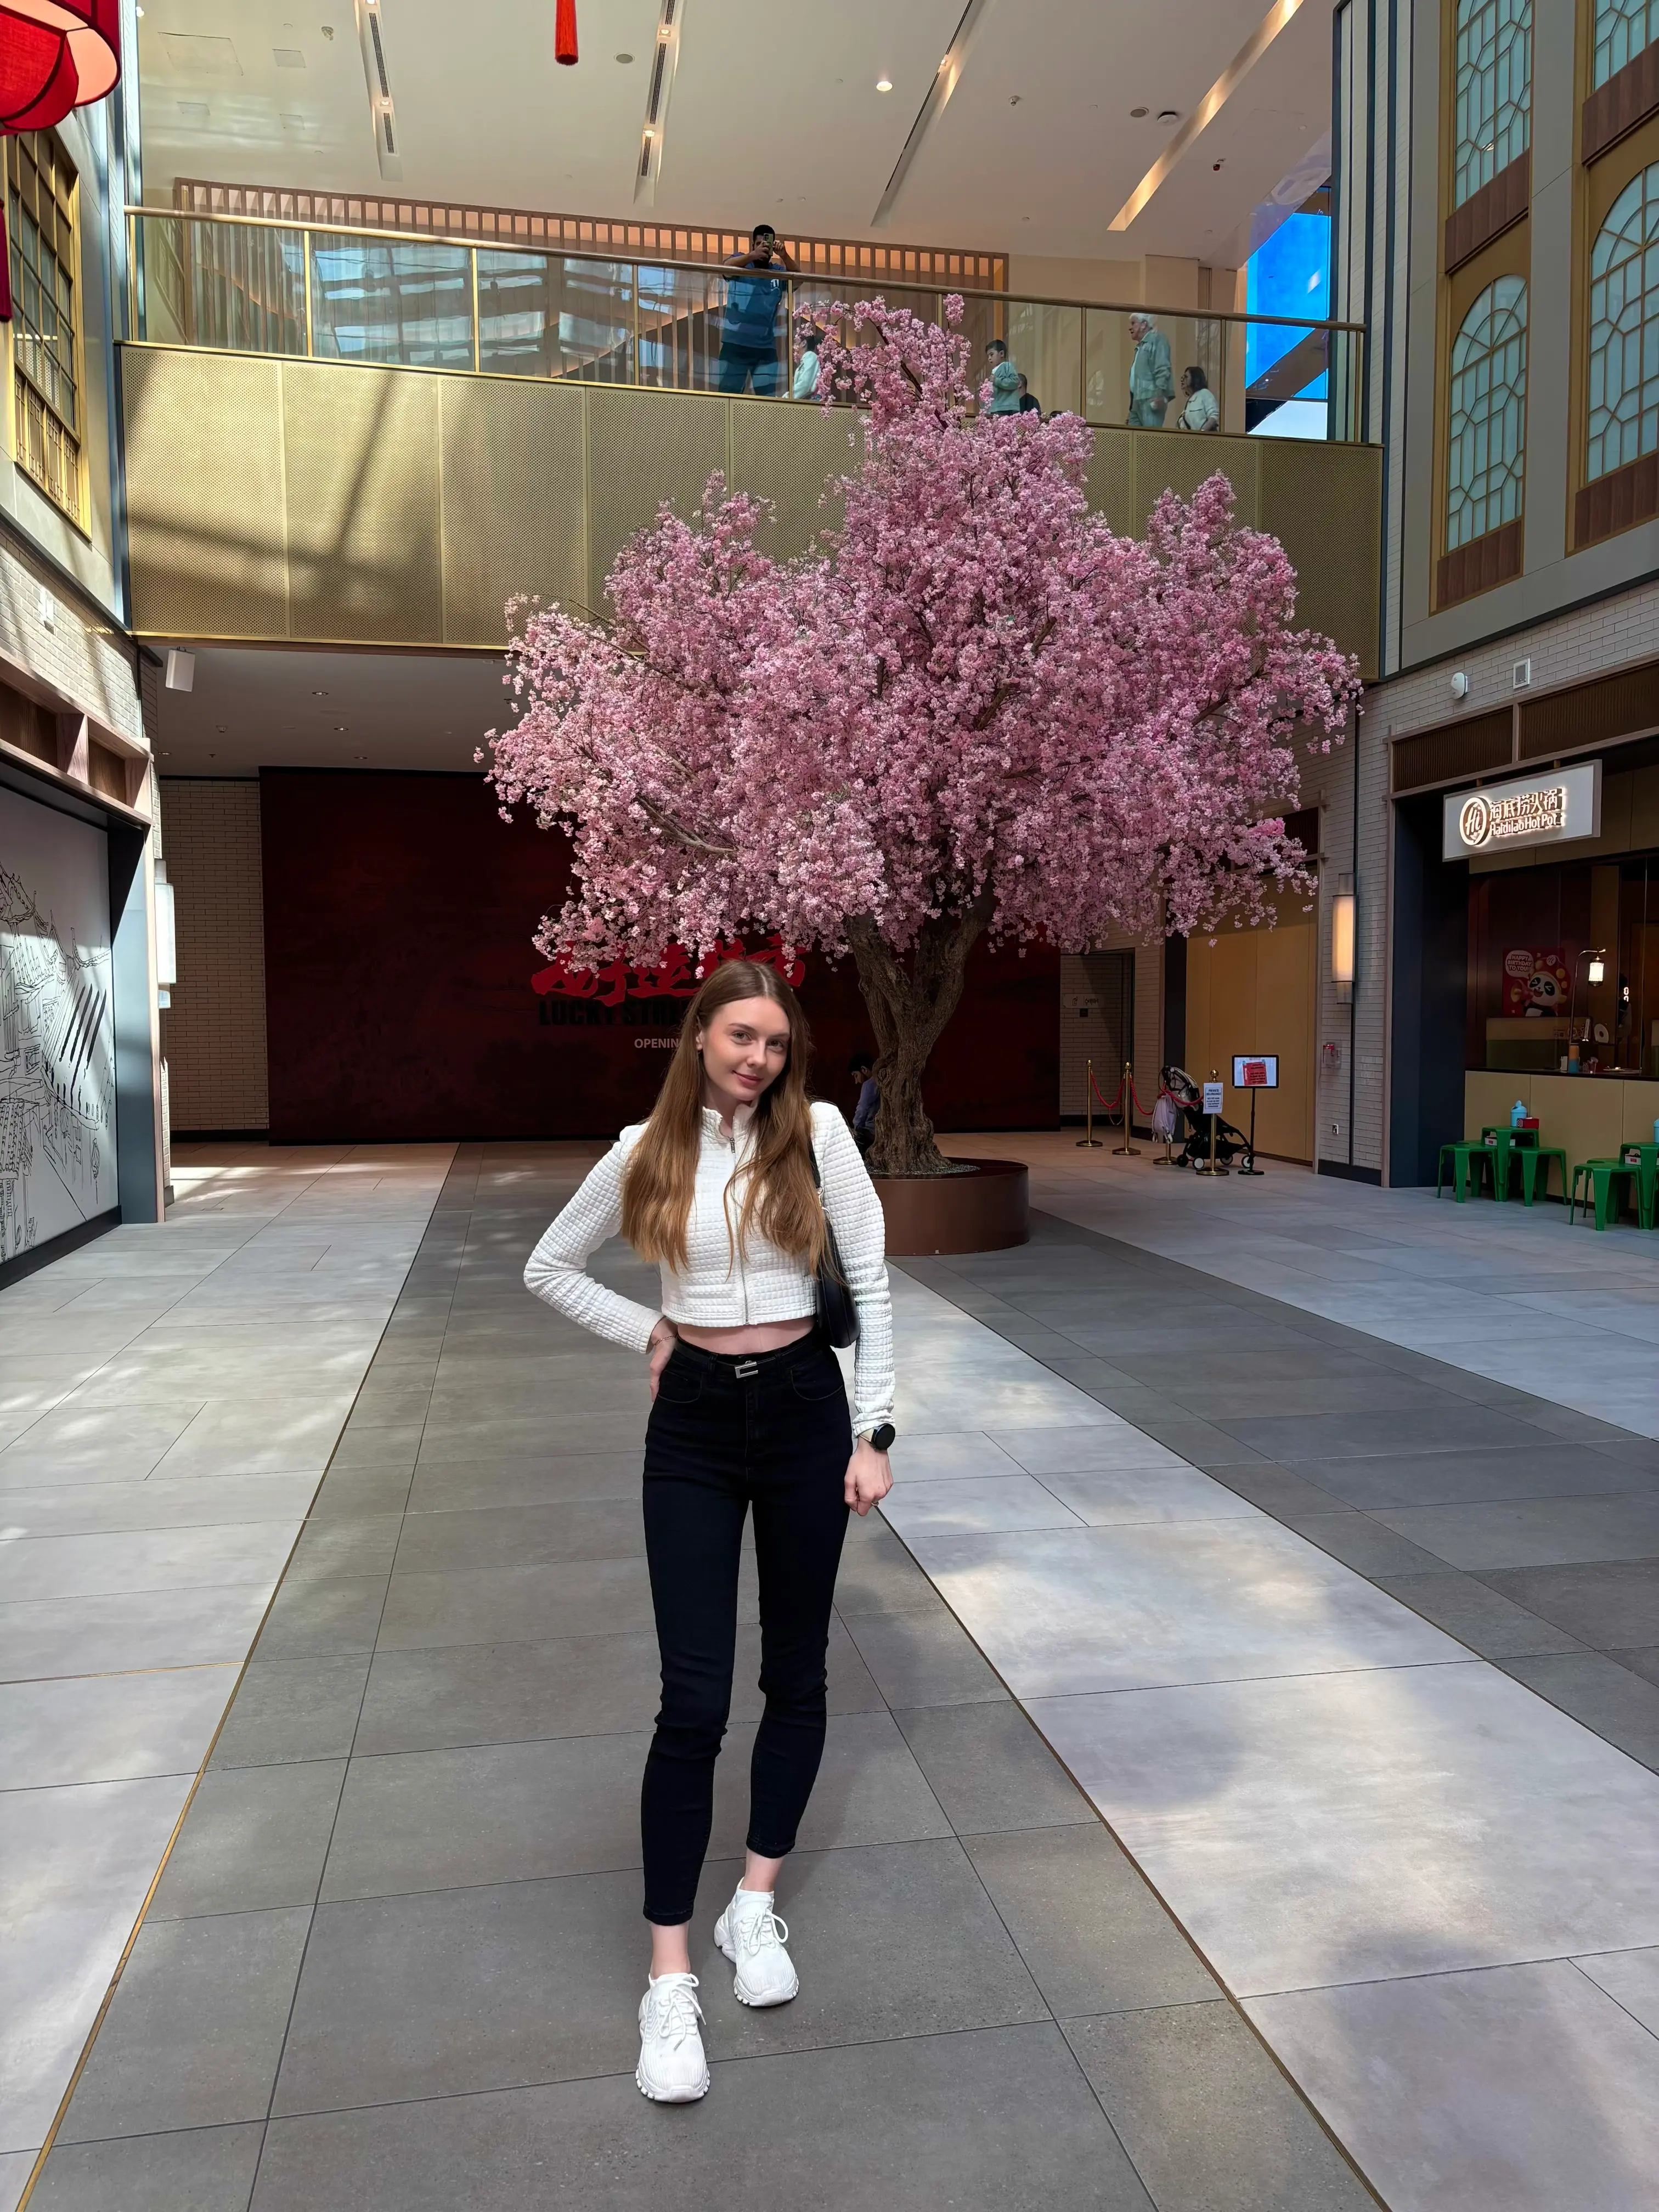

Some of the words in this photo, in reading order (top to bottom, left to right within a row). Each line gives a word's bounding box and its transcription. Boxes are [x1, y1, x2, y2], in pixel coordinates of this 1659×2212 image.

[1489, 788, 1558, 822] 海底捞火锅
[1489, 820, 1525, 836] Haidilao
[1525, 816, 1541, 830] Hot
[1541, 814, 1558, 827] Pot
[539, 1000, 613, 1025] LUCKY
